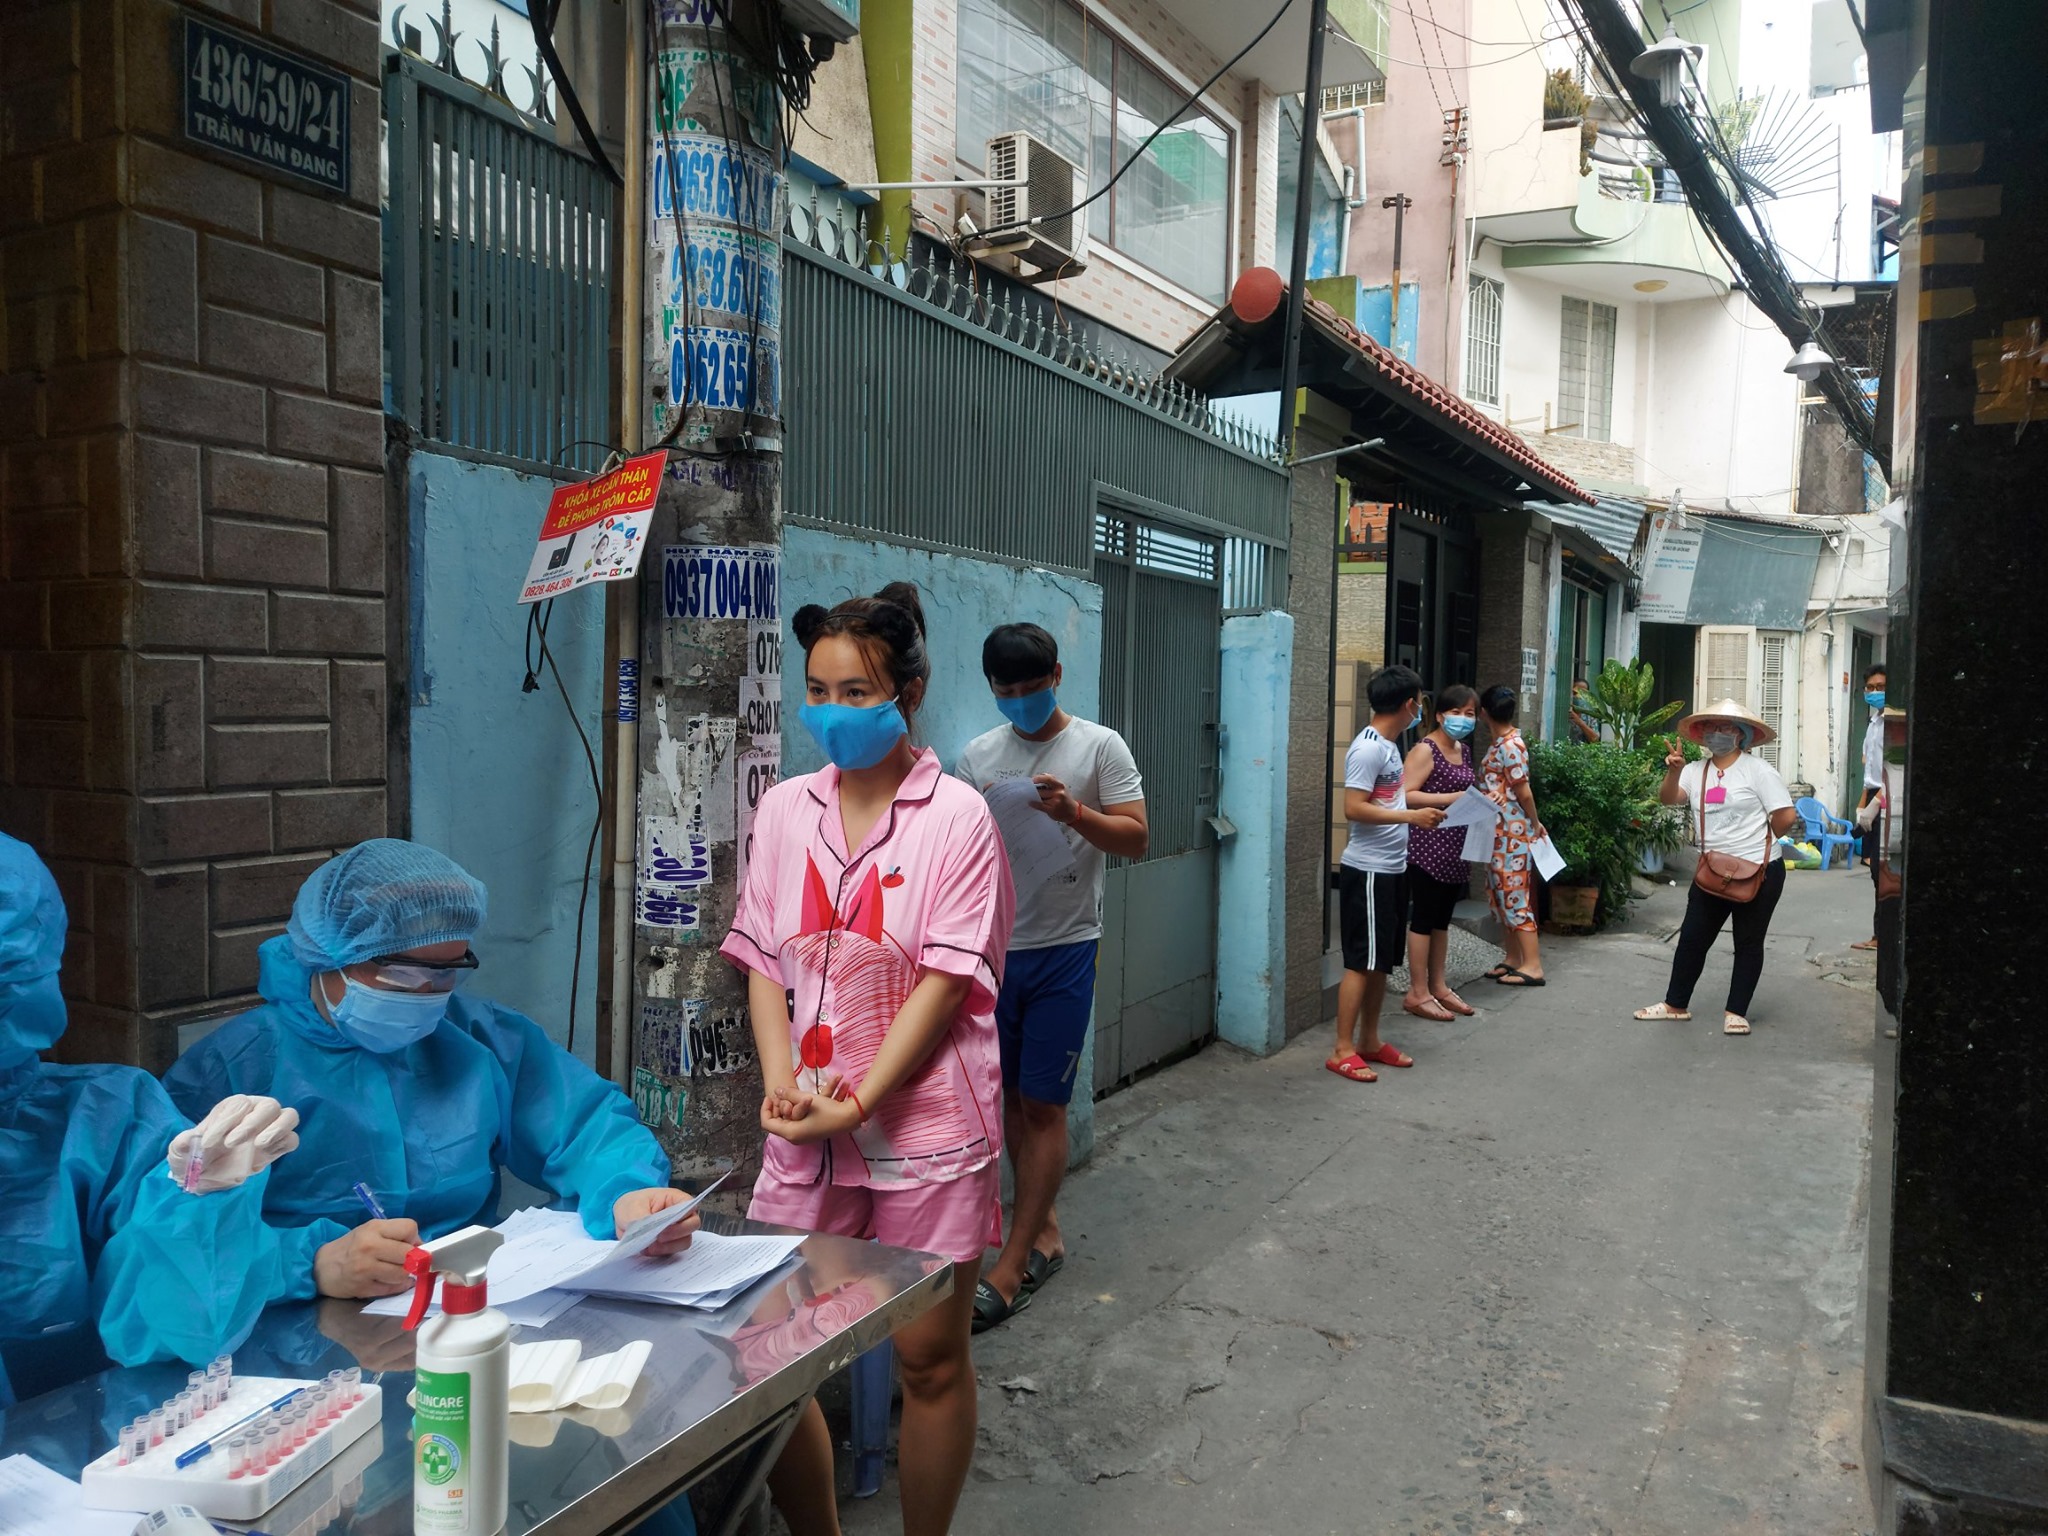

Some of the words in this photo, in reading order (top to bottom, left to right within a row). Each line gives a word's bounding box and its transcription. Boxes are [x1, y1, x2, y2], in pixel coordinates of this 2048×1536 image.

[192, 37, 340, 149] 436/59/24
[194, 112, 245, 148] TRẦN
[250, 133, 286, 163] VĂN
[290, 147, 339, 181] ĐANG
[564, 492, 589, 509] KHÓA
[620, 467, 649, 487] THẬN
[571, 503, 600, 525] PHÒNG
[601, 491, 625, 514] TRỘM
[627, 482, 652, 505] CẮP
[665, 558, 776, 620] 0937.004.002
[1060, 1050, 1079, 1083] 7
